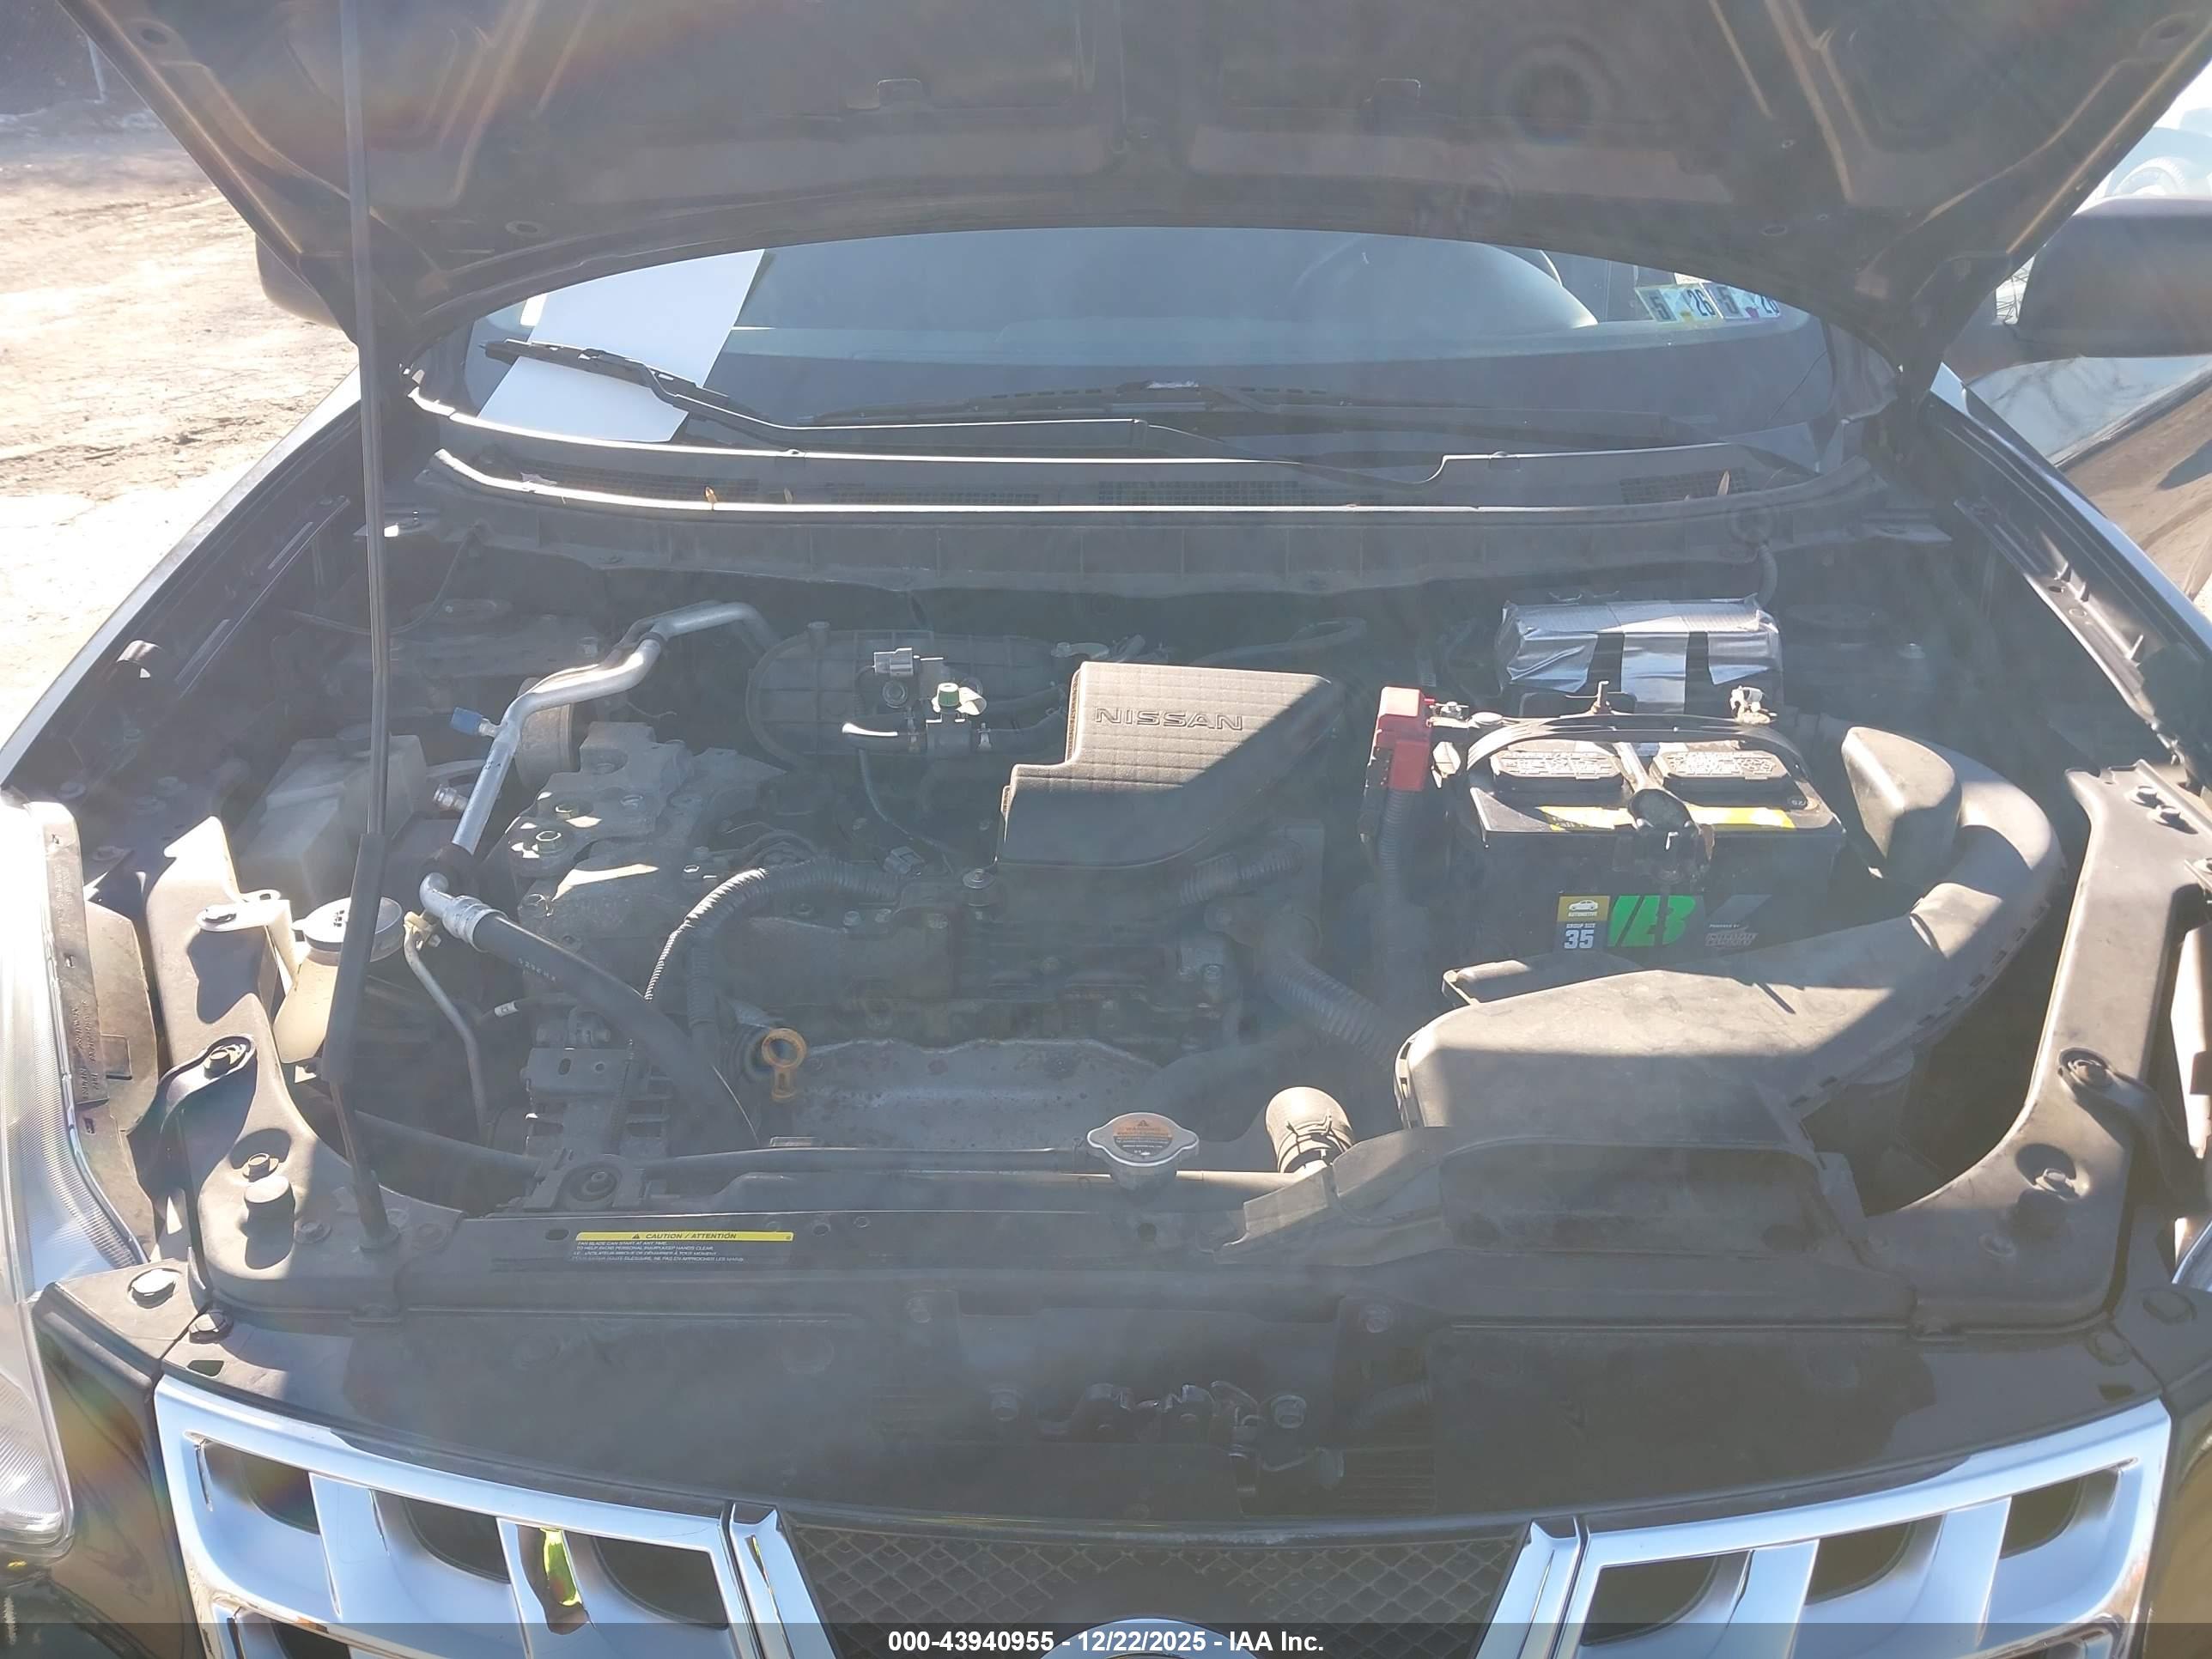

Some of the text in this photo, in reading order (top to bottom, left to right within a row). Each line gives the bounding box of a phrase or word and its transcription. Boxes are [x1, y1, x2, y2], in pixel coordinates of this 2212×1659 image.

[1650, 289, 1716, 320] 5 26
[1095, 707, 1243, 731] NISSAN
[1564, 930, 1594, 949] 35
